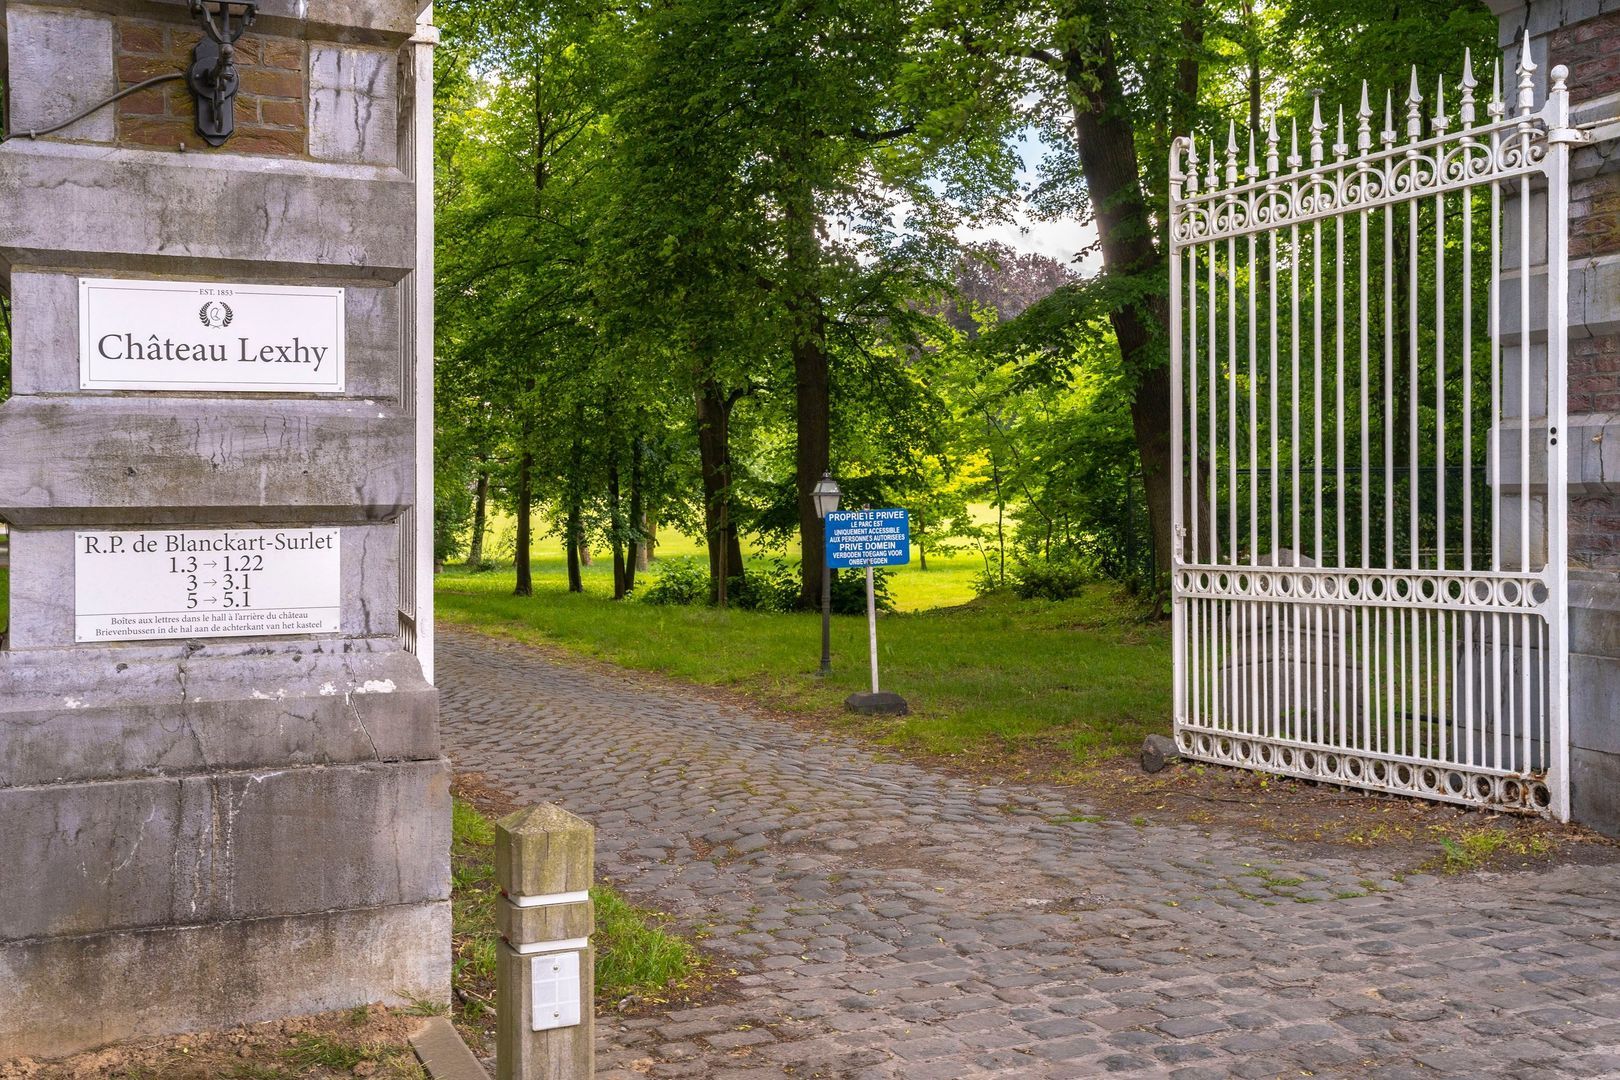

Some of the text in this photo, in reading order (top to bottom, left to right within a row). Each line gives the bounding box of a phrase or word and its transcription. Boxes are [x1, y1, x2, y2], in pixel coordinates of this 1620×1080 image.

[199, 288, 233, 297] EST. 1853
[98, 333, 329, 372] Château Lexhy
[834, 528, 868, 536] UNIQUEMENT
[841, 535, 873, 543] PERSONNES
[84, 532, 333, 554] R.P. de Blanckart-Surlet
[839, 541, 896, 551] PRIVE DOMEIN
[888, 549, 903, 557] VOOR
[169, 555, 264, 573] 1.3 1.22
[186, 574, 251, 592] 3 3.1
[186, 591, 251, 609] 5 5.1
[111, 617, 136, 625] Boîtes
[155, 615, 180, 624] lettres
[182, 614, 201, 623] dans
[202, 614, 210, 622] le
[211, 613, 227, 622] hall
[228, 613, 233, 621] à
[266, 612, 277, 620] du
[279, 611, 308, 619] château
[95, 626, 156, 636] Brievenbussen
[157, 626, 166, 634] in
[168, 625, 178, 633] de
[180, 625, 193, 633] hal
[211, 624, 221, 632] de
[222, 622, 264, 631] achterkant
[282, 621, 295, 629] het
[296, 620, 323, 629] kasteel
